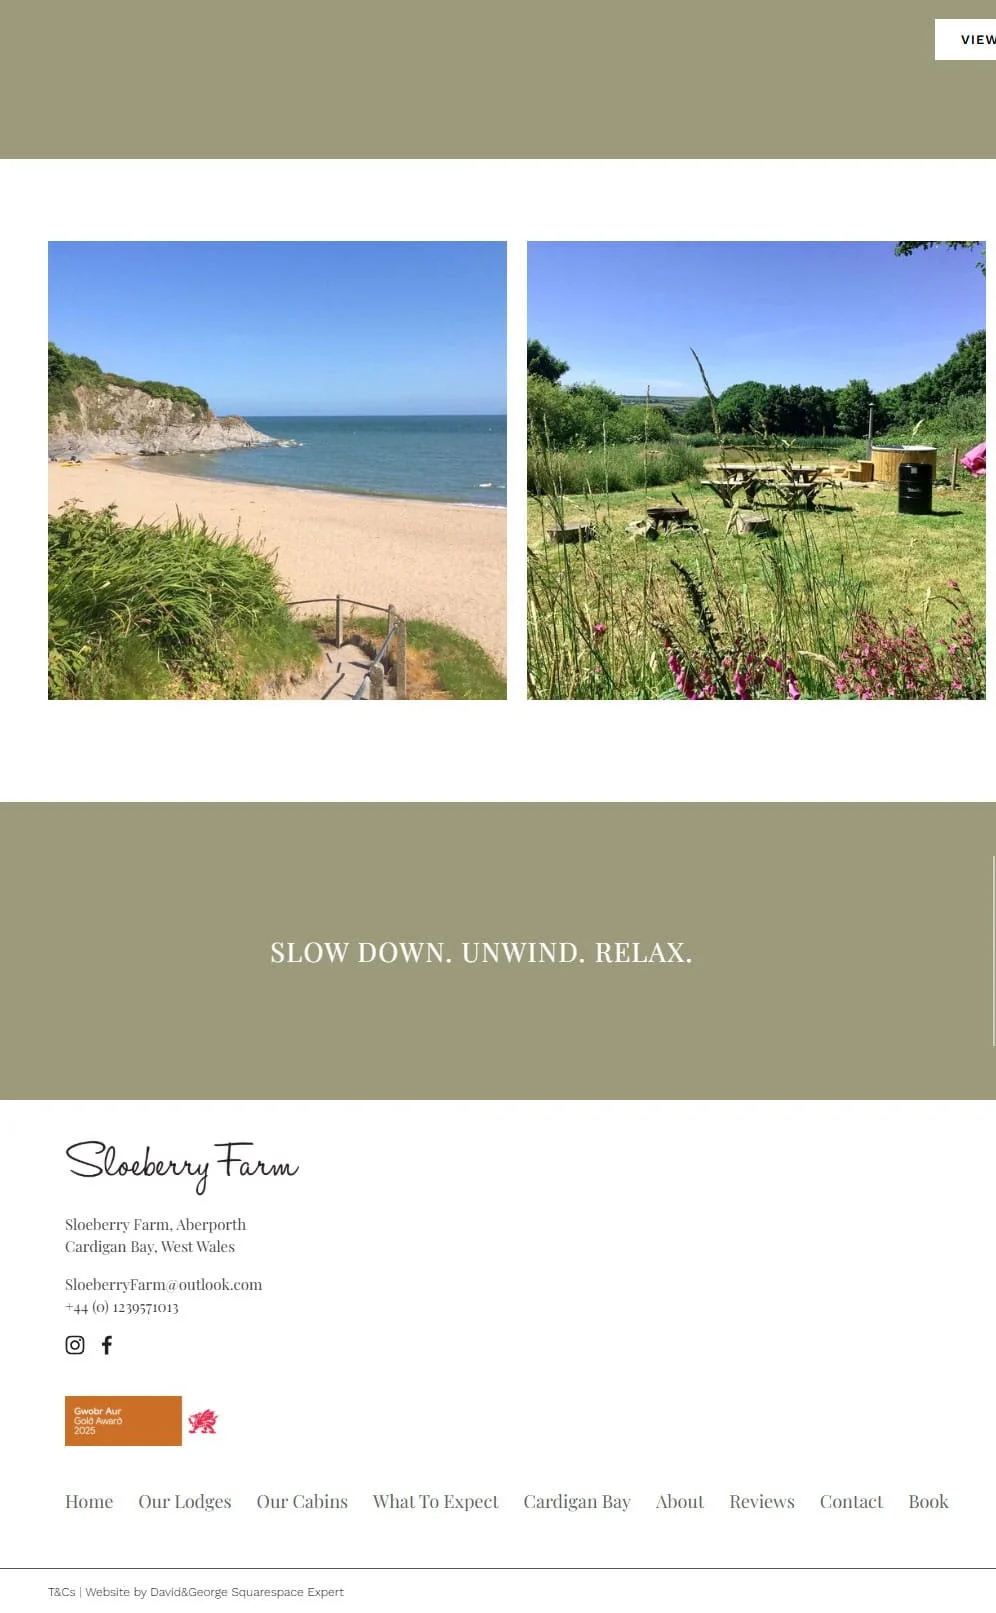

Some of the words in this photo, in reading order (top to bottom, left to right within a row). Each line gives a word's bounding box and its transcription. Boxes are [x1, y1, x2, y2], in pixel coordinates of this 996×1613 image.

[271, 941, 350, 964] SLOW
[357, 941, 452, 964] DOWN.
[461, 942, 585, 964] UNWIND.
[595, 942, 692, 964] RELAX.
[66, 1140, 209, 1196] Sloeberry
[213, 1141, 300, 1176] Farm
[65, 1217, 131, 1234] Sloeberry
[133, 1218, 174, 1233] Farm,
[175, 1217, 247, 1234] Aberporth
[64, 1239, 127, 1256] Cardigan
[130, 1240, 158, 1256] Bay,
[160, 1240, 194, 1253] West
[195, 1239, 236, 1253] Wales
[65, 1277, 263, 1294] SloeberryFarm@outlook.com
[112, 1303, 179, 1316] 1239571013
[73, 1406, 105, 1416] Gwobr
[104, 1406, 122, 1416] Aur
[73, 1416, 95, 1426] Gold
[95, 1416, 124, 1426] Award
[73, 1426, 96, 1436] 2025
[65, 1494, 114, 1509] Home
[138, 1494, 171, 1509] Our
[174, 1493, 232, 1513] Lodges
[256, 1494, 289, 1509] Our
[292, 1493, 348, 1509] Cabins
[372, 1493, 417, 1509] What
[418, 1494, 440, 1509] To
[443, 1494, 500, 1513] Expect
[523, 1493, 598, 1513] Cardigan
[601, 1494, 632, 1513] Bay
[655, 1493, 705, 1509] About
[729, 1493, 795, 1509] Reviews
[820, 1494, 885, 1509] Contact
[908, 1493, 950, 1509] Book
[47, 1587, 76, 1597] T&Cs
[85, 1586, 130, 1597] Website
[133, 1586, 148, 1600] by
[150, 1587, 228, 1600] David&George
[231, 1587, 304, 1599] Squarespace
[307, 1587, 345, 1600] Expert
